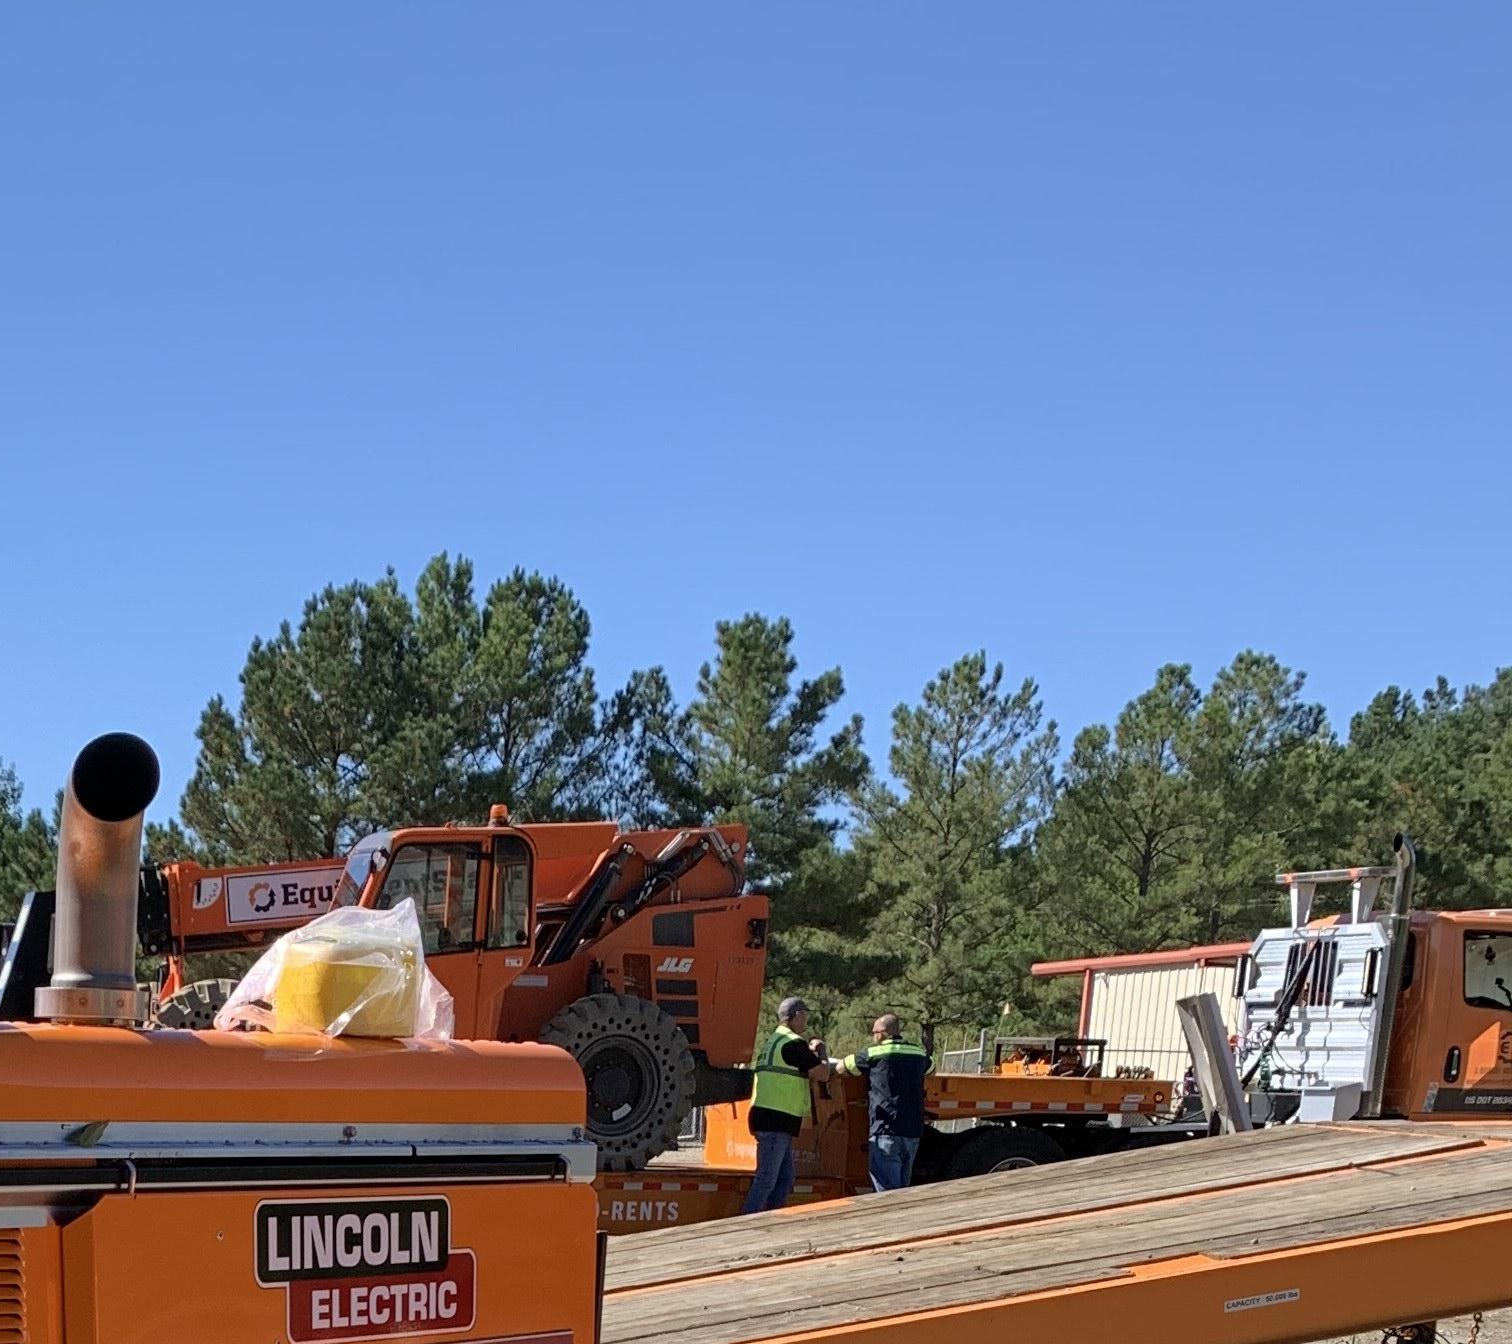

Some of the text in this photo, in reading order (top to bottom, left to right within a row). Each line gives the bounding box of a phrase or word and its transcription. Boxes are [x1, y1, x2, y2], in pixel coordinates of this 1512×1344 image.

[656, 957, 694, 973] JLG
[267, 1211, 439, 1271] LINCOLN
[311, 1280, 457, 1330] ELECTRIC
[1226, 1297, 1261, 1309] CAPACITY
